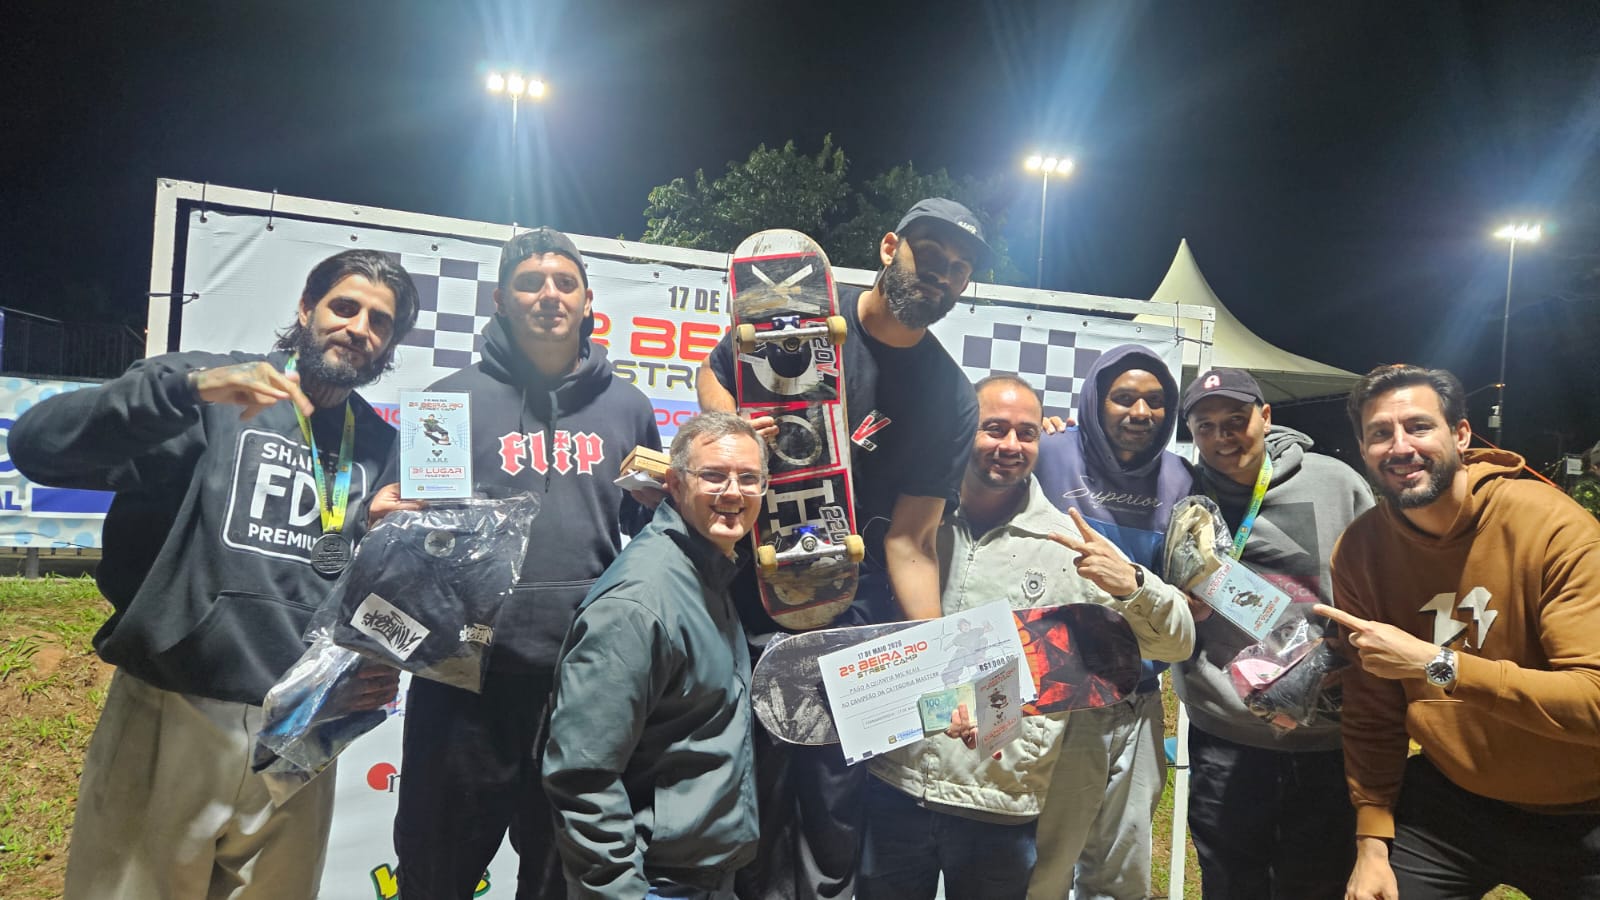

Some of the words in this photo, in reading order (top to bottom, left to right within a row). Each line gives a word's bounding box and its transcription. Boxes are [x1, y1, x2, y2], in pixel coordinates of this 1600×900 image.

[668, 286, 690, 309] 17
[694, 288, 720, 314] DE
[630, 316, 731, 362] BE
[611, 359, 700, 391] STR
[1203, 374, 1221, 389] A
[248, 522, 318, 551] PREMIU
[839, 663, 855, 677] 2º
[858, 650, 902, 670] BEIRA
[903, 641, 928, 656] RIO
[857, 662, 891, 678] STREET
[893, 654, 918, 667] CAMP
[924, 698, 940, 707] 100
